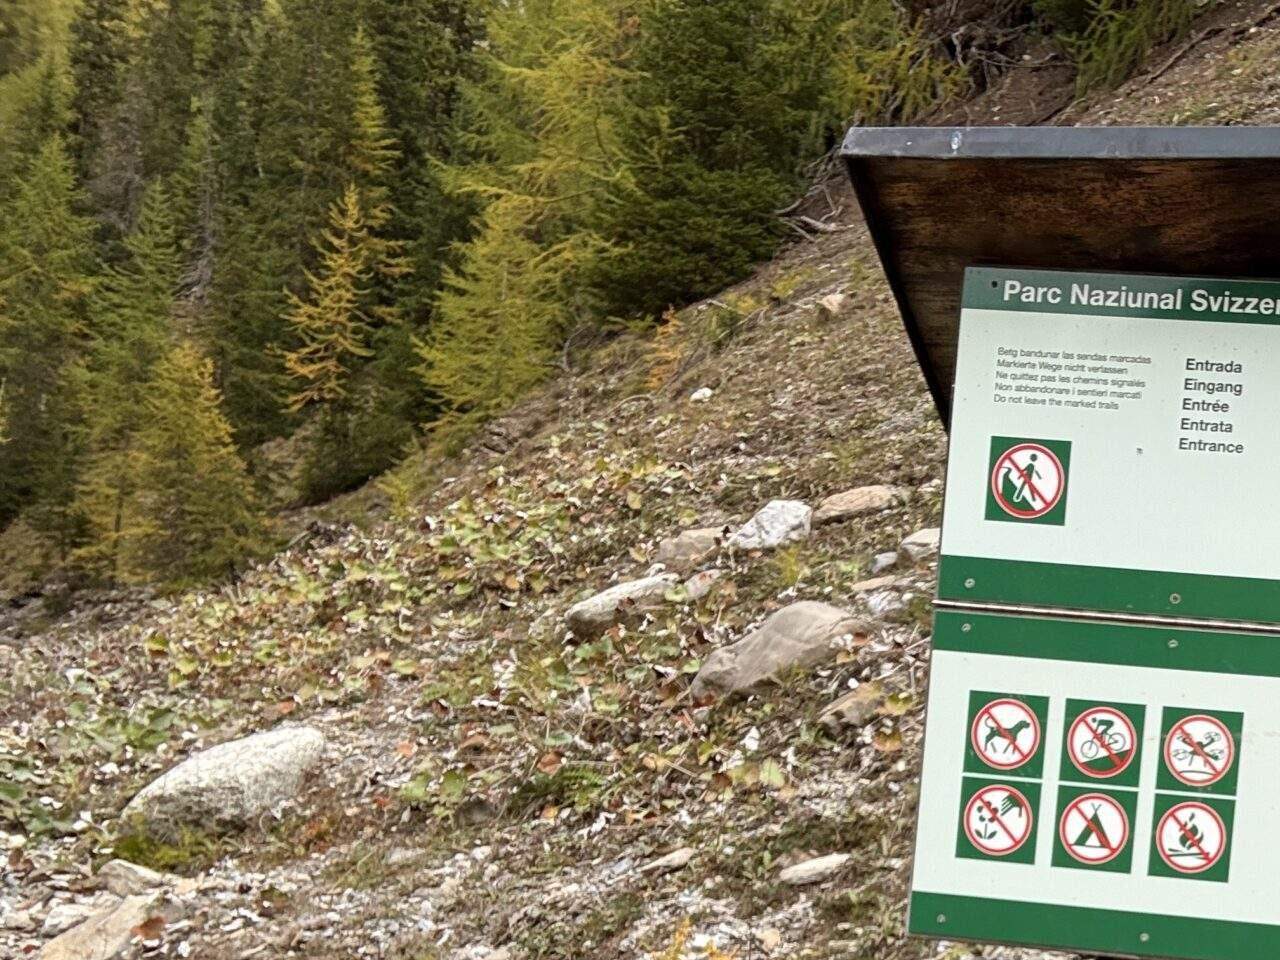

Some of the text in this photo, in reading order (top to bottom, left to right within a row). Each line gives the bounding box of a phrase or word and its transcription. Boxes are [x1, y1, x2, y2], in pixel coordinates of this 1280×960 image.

[1003, 280, 1062, 304] Parc
[1070, 283, 1181, 310] Naziunal
[1062, 351, 1075, 359] las
[1076, 352, 1107, 362] sendas
[1109, 354, 1152, 364] marcadas
[1185, 358, 1242, 373] Entrada
[997, 359, 1128, 375] Markierte Wege nicht verlassen
[996, 371, 1008, 379] Ne
[1010, 372, 1038, 382] quittez
[1040, 375, 1056, 383] pas
[1059, 375, 1071, 383] les
[1073, 376, 1109, 386] chemins
[995, 383, 1012, 391] Non
[1015, 384, 1070, 395] abbandonare
[1077, 388, 1107, 397] sentieri
[1109, 390, 1142, 399] marcati
[1184, 378, 1243, 396] Eingang
[994, 394, 1119, 410] Do not leave the marked trails
[1182, 398, 1229, 412] Entrée
[1180, 418, 1233, 433] Entrata
[1178, 437, 1244, 453] Entrance
